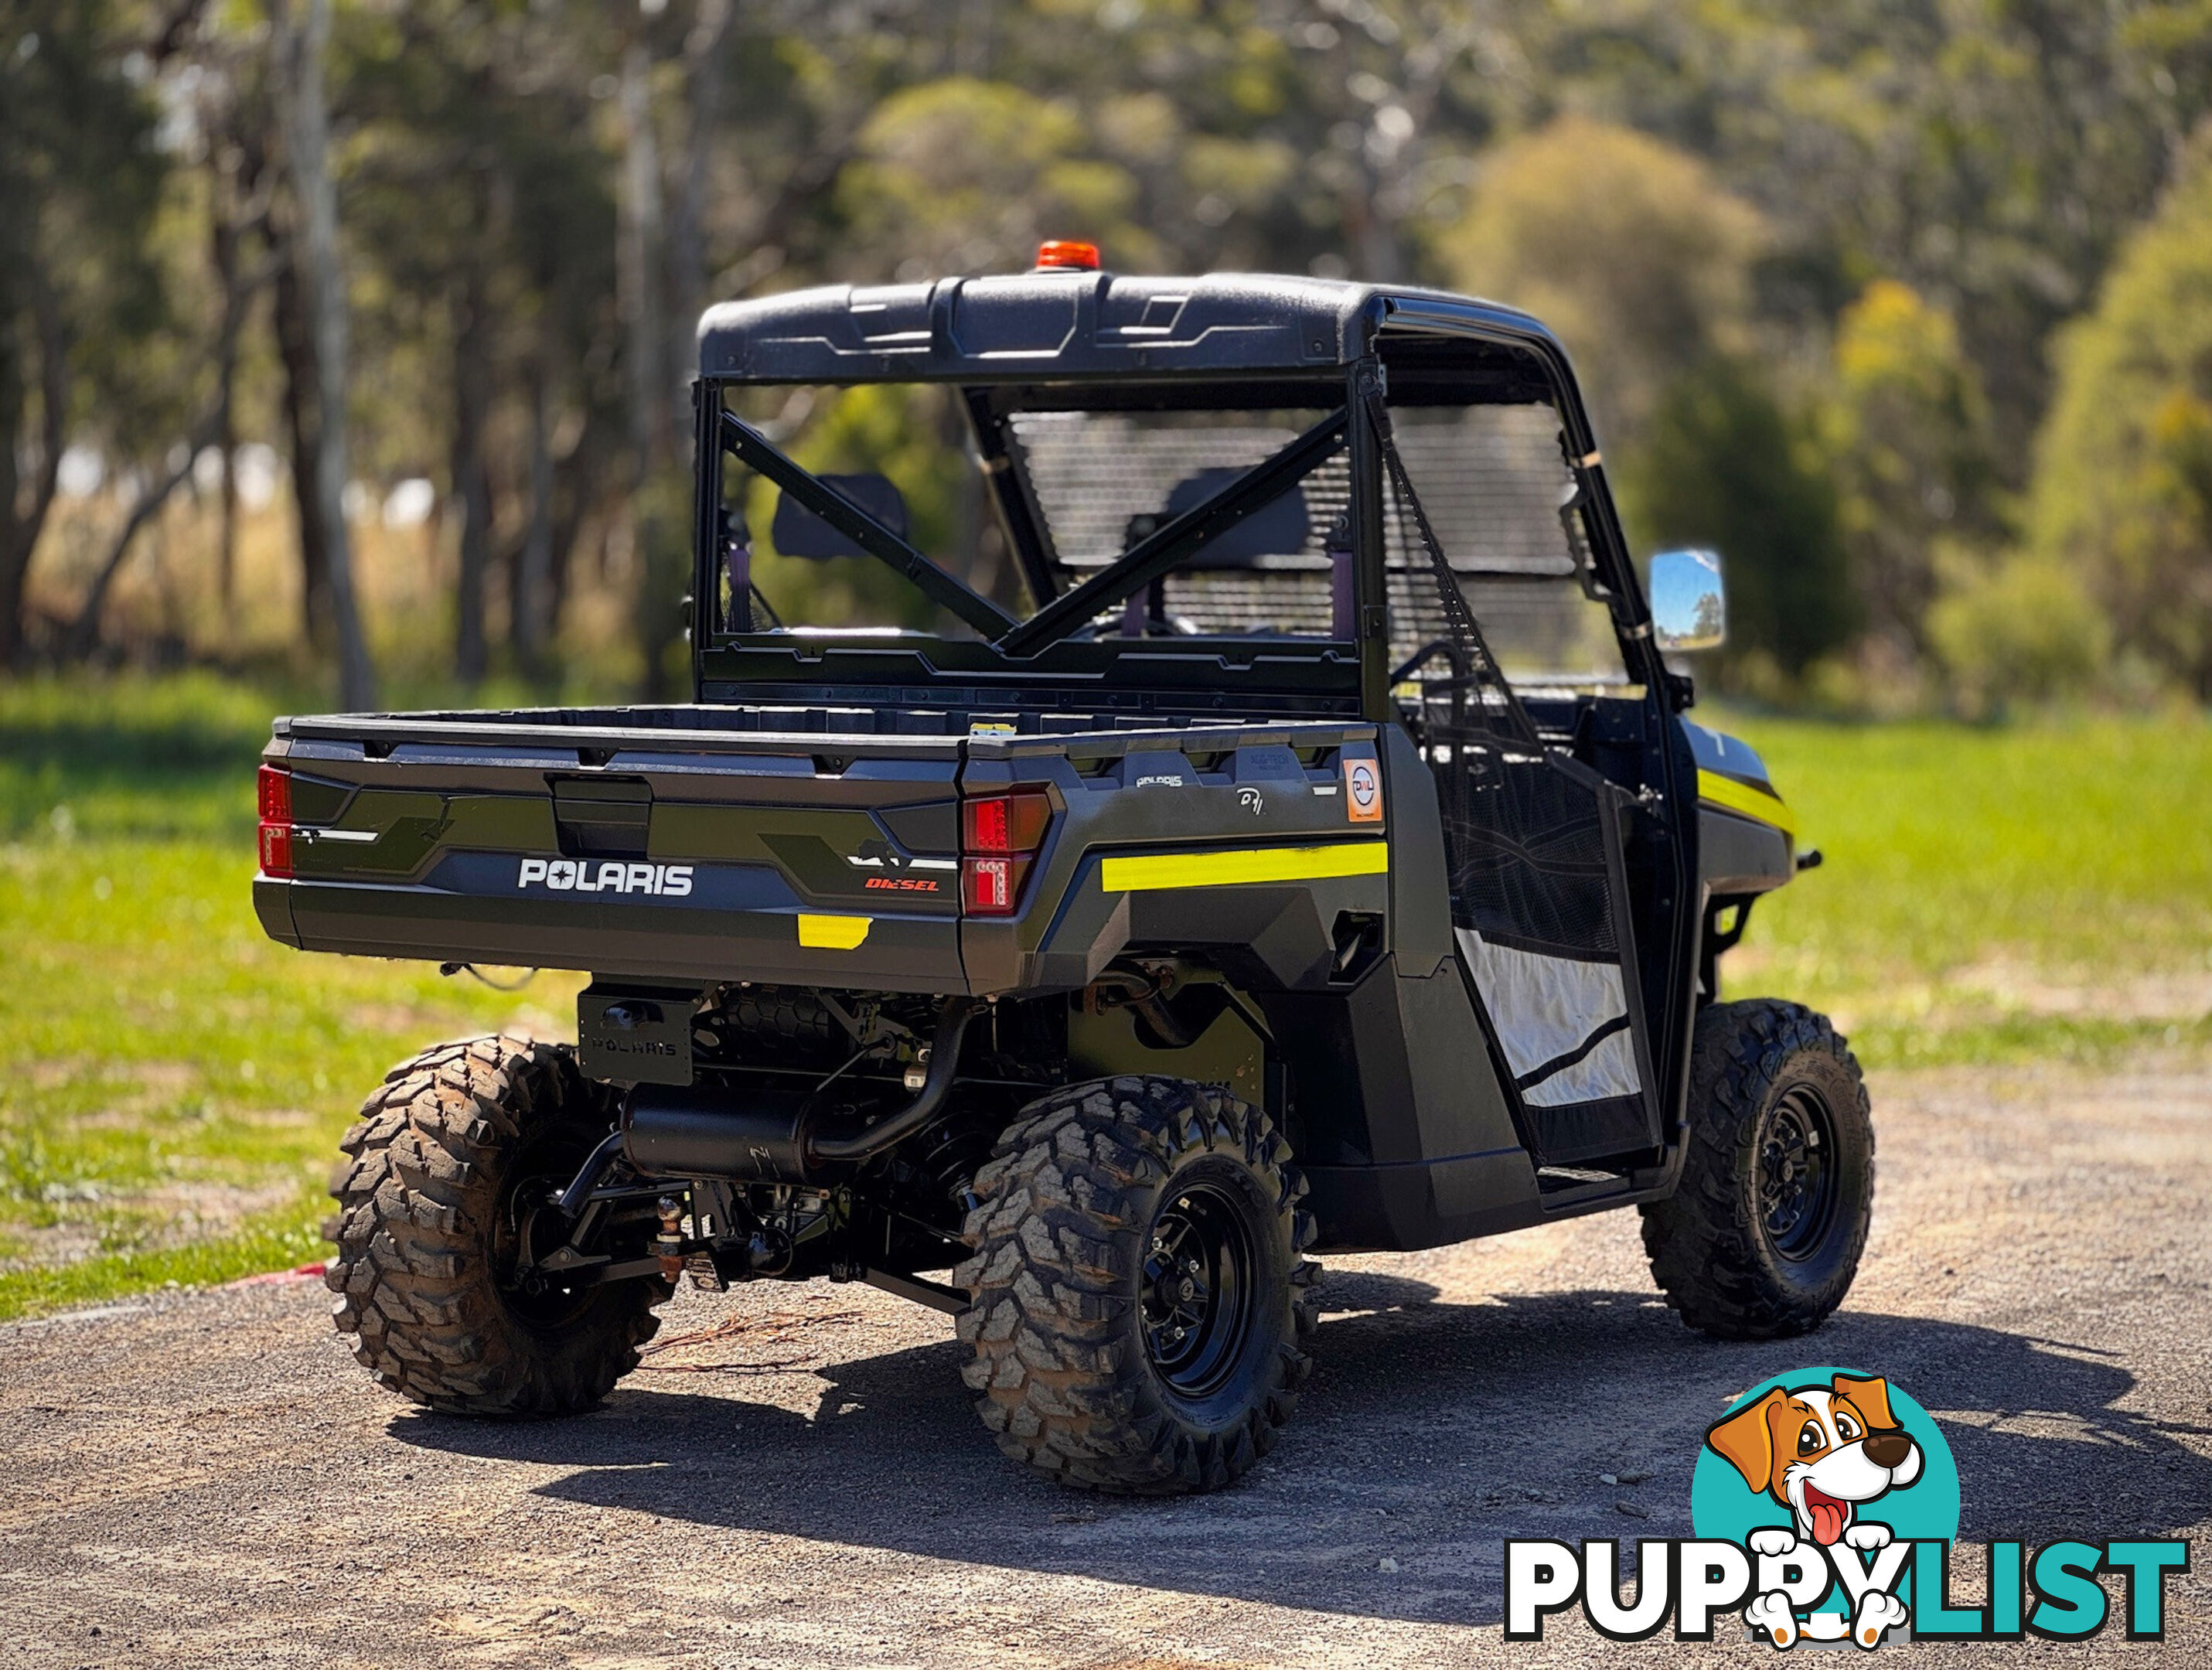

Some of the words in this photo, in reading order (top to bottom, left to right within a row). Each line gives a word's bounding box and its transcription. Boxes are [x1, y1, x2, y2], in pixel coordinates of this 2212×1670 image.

[1137, 775, 1182, 788] POLARIS
[517, 857, 694, 897] POLARIS
[864, 878, 939, 892] DIESEL
[592, 1038, 677, 1056] POLARIS
